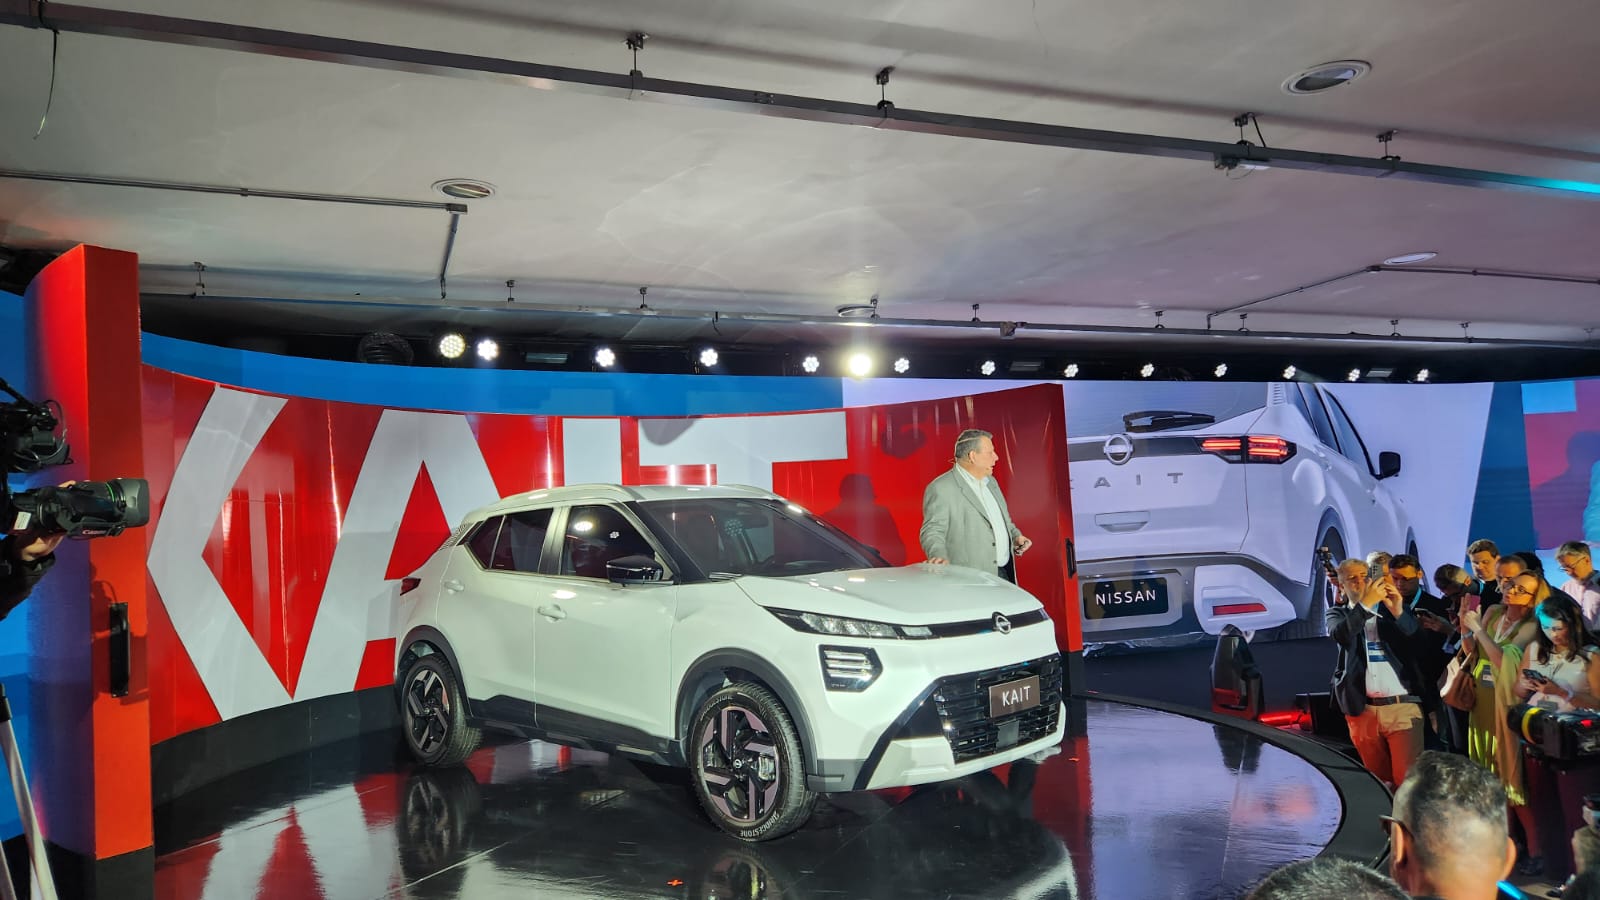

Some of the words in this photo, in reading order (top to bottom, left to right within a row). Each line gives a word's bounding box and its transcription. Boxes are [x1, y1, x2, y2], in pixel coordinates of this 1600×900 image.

[1070, 472, 1184, 489] AIT
[147, 385, 848, 722] KAT
[1095, 589, 1157, 606] NISSAN
[1002, 685, 1032, 708] KAIT
[740, 810, 780, 838] BRIDGESTONE
